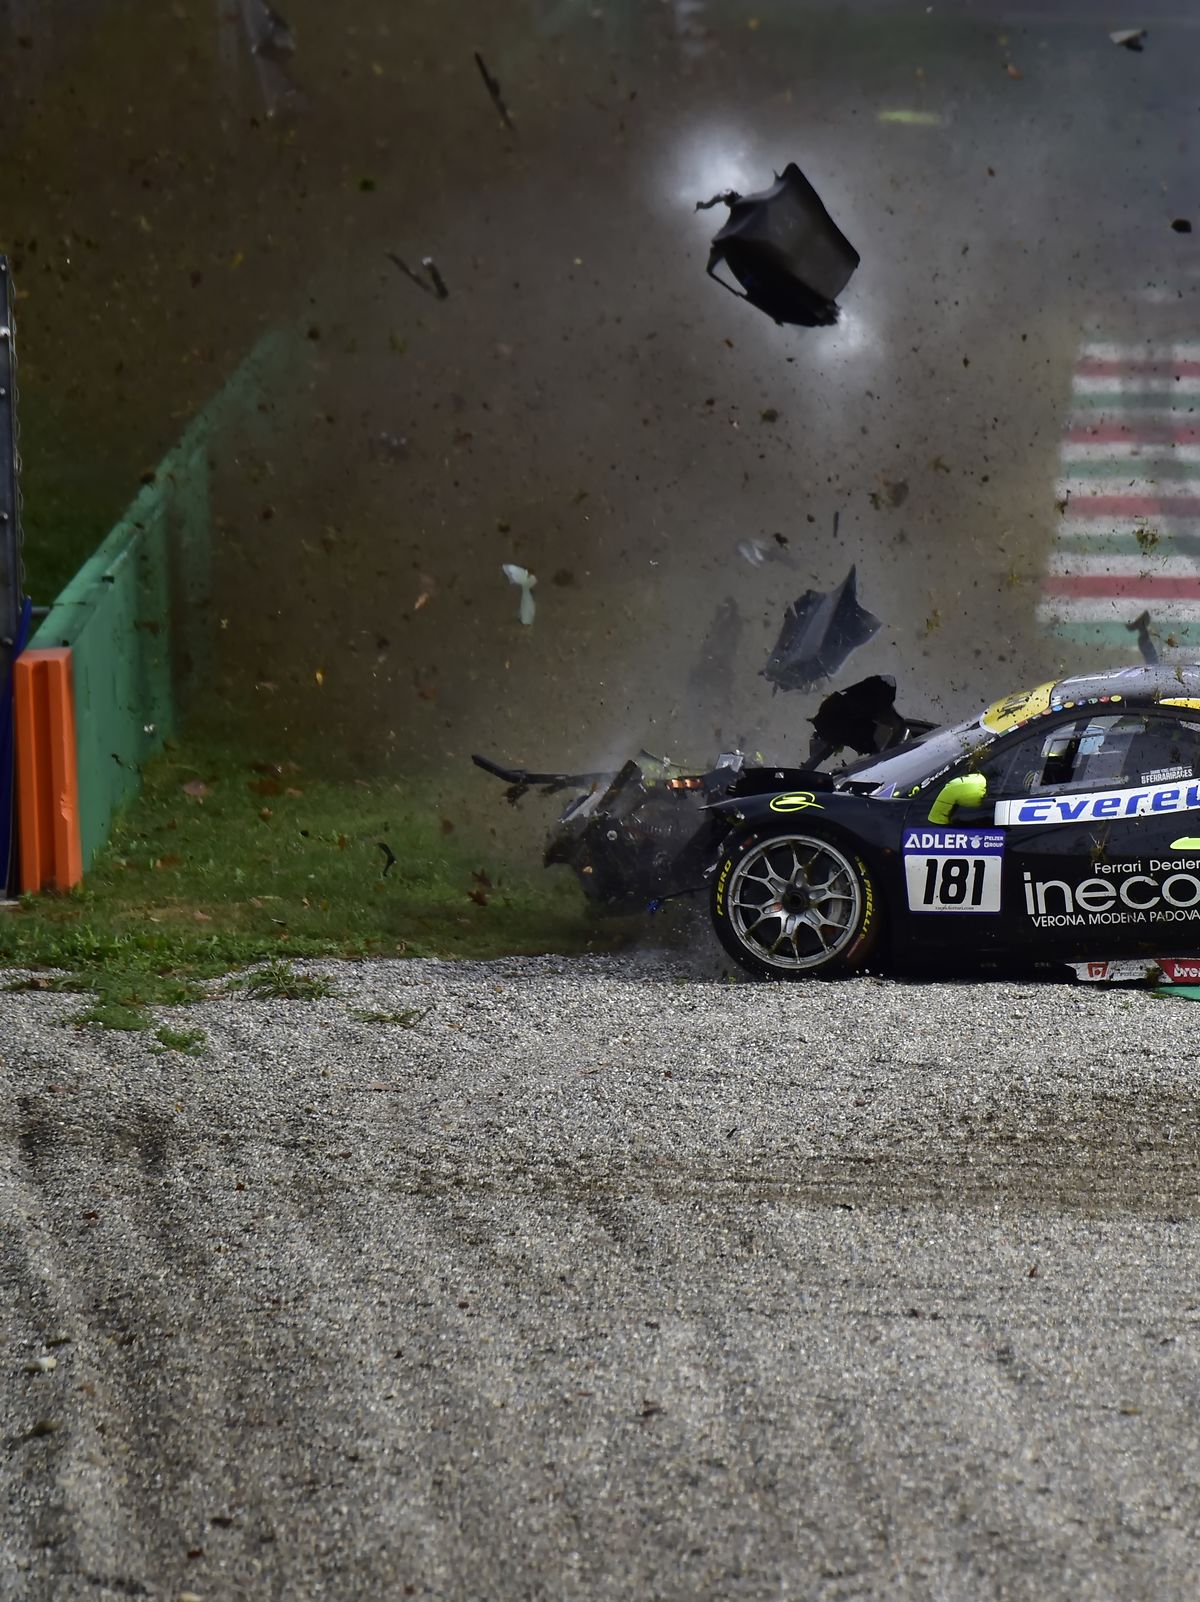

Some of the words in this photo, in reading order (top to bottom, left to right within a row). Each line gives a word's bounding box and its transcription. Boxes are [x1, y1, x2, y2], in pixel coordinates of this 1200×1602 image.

[904, 834, 968, 849] ADLER
[1094, 860, 1142, 874] Ferrari
[923, 858, 986, 906] 181
[862, 878, 874, 936] PIRELLI
[1031, 914, 1086, 928] VERONA
[1089, 912, 1147, 926] MODENA
